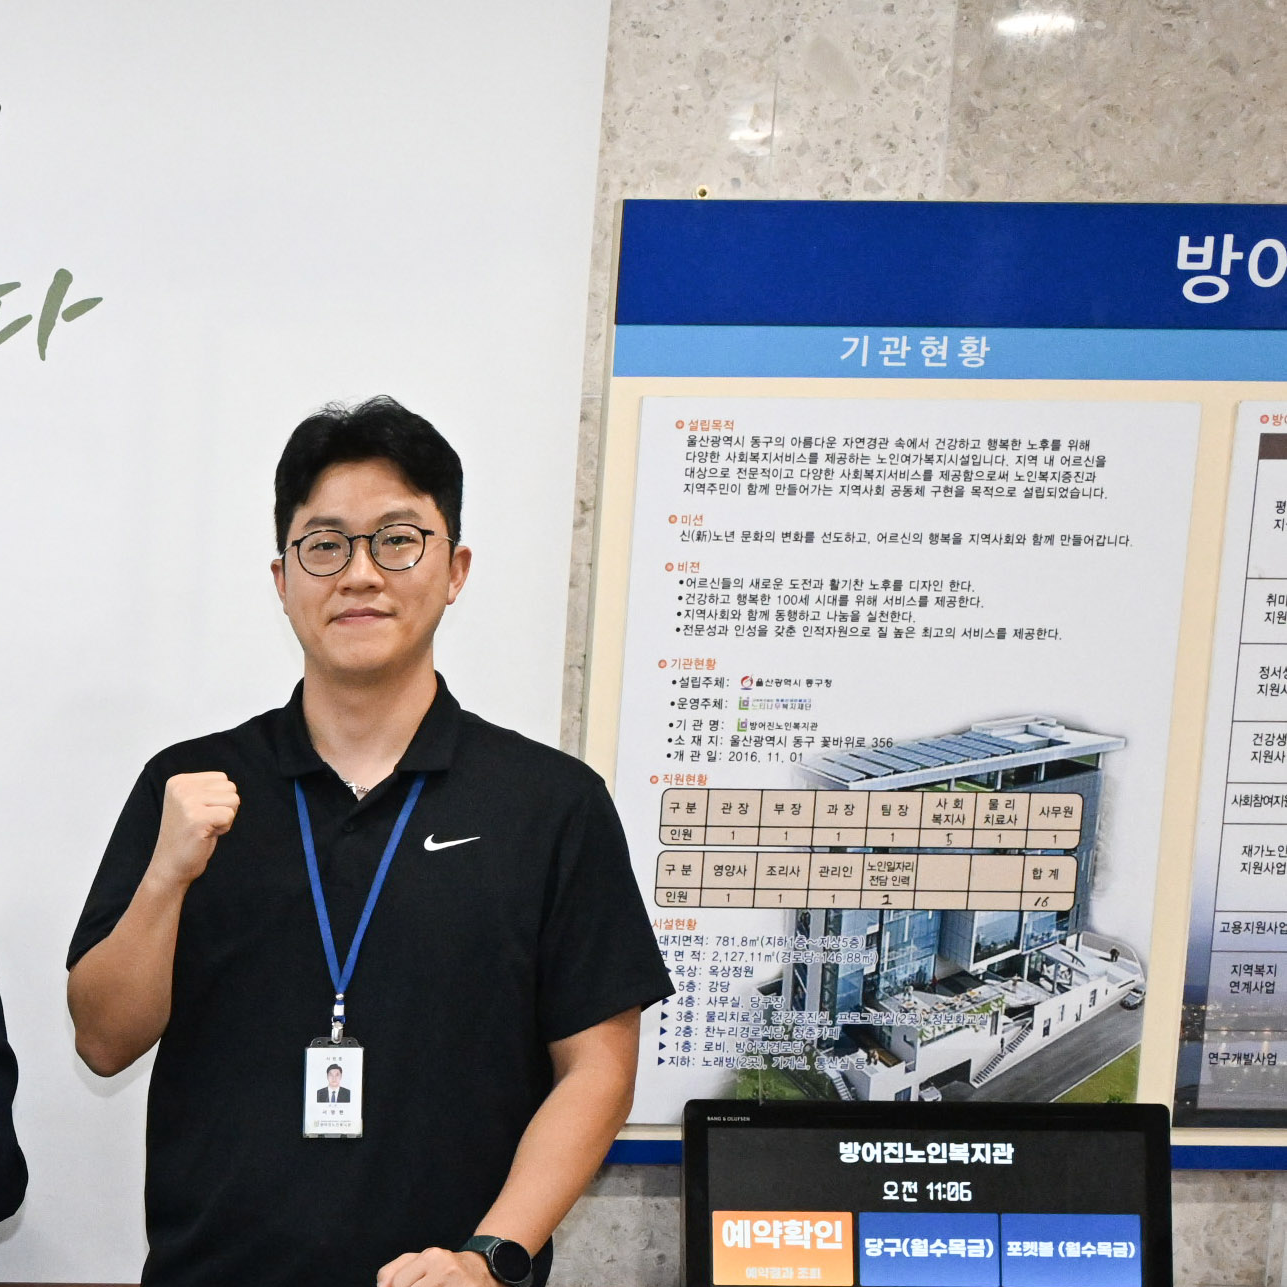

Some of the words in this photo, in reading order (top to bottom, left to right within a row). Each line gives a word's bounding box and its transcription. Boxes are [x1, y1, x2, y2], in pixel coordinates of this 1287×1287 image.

[840, 335, 992, 368] 기관현황
[688, 419, 735, 431] 설립목적
[686, 435, 745, 448] 울산광역시
[750, 436, 785, 448] 동구의
[790, 436, 836, 448] 아름다운
[842, 436, 889, 449] 자연경관
[894, 438, 929, 449] 속에서
[935, 438, 981, 450] 건강하고
[987, 438, 1022, 450] 행복한
[1027, 439, 1062, 451] 노후를
[1068, 439, 1090, 451] 위해
[685, 451, 720, 464] 다양한
[726, 452, 818, 464] 사회복지서비스를
[825, 452, 871, 465] 제공하는
[876, 452, 1008, 467] 노인여가복지시설입니다.
[1015, 454, 1038, 467] 지역
[1044, 454, 1054, 467] 내
[1060, 455, 1106, 468] 어르신을
[684, 467, 730, 479] 대상으로
[736, 468, 794, 480] 전문적이고
[800, 468, 834, 480] 다양한
[840, 468, 934, 482] 사회복지서비스를
[938, 470, 1009, 482] 제공함으로써
[1014, 470, 1096, 483] 노인복지증진과
[683, 483, 741, 495] 지역주민이
[747, 484, 770, 496] 함께
[775, 484, 833, 496] 만들어가는
[838, 484, 885, 496] 지역사회
[890, 485, 925, 497] 공동체
[930, 486, 965, 498] 구현을
[970, 486, 1016, 498] 목적으로
[1022, 486, 1108, 500] 설립되었습니다.
[681, 514, 704, 526] 미션
[680, 530, 735, 543] 신(新)노년
[740, 530, 775, 542] 문화의
[781, 530, 816, 543] 변화를
[821, 531, 870, 544] 선도하고,
[876, 532, 922, 544] 어르신의
[928, 532, 962, 545] 행복을
[968, 533, 1026, 546] 지역사회와
[1032, 534, 1054, 546] 함께
[1060, 534, 1132, 547] 만들어갑니다.
[686, 577, 744, 590] 어르신들의
[749, 578, 783, 590] 새로운
[789, 578, 824, 591] 도전과
[829, 578, 864, 591] 활기찬
[869, 579, 903, 592] 노후를
[909, 579, 943, 592] 디자인
[949, 580, 975, 592] 한다.
[685, 593, 730, 606] 건강하고
[737, 594, 771, 606] 행복한
[777, 594, 810, 606] 100세
[815, 594, 850, 607] 시대를
[855, 595, 878, 608] 위해
[883, 595, 928, 608] 서비스를
[934, 596, 984, 608] 제공한다.
[684, 608, 742, 621] 지역사회와
[747, 609, 770, 622] 함께
[775, 610, 820, 622] 동행하고
[826, 610, 860, 622] 나눔을
[866, 610, 916, 623] 실천한다.
[682, 624, 728, 636] 전문성과
[734, 624, 768, 637] 인성을
[774, 625, 796, 637] 갖춘
[802, 626, 871, 638] 인적자원으로
[877, 626, 888, 638] 질
[894, 626, 916, 638] 높은
[922, 626, 956, 639] 최고의
[962, 628, 1006, 640] 서비스를
[1012, 628, 1062, 640] 제공한다.
[1230, 964, 1277, 977] 지역복지
[1229, 981, 1276, 994] 연계사업
[1208, 1052, 1277, 1066] 연구개발사업
[838, 1141, 1014, 1166] 방어진노인복지관
[882, 1181, 918, 1202] 오전
[722, 1219, 844, 1251] 예약확인
[864, 1236, 994, 1260] 당구(월수목금)
[1006, 1240, 1054, 1258] 포켓볼
[1058, 1240, 1136, 1260] (월수목금)
